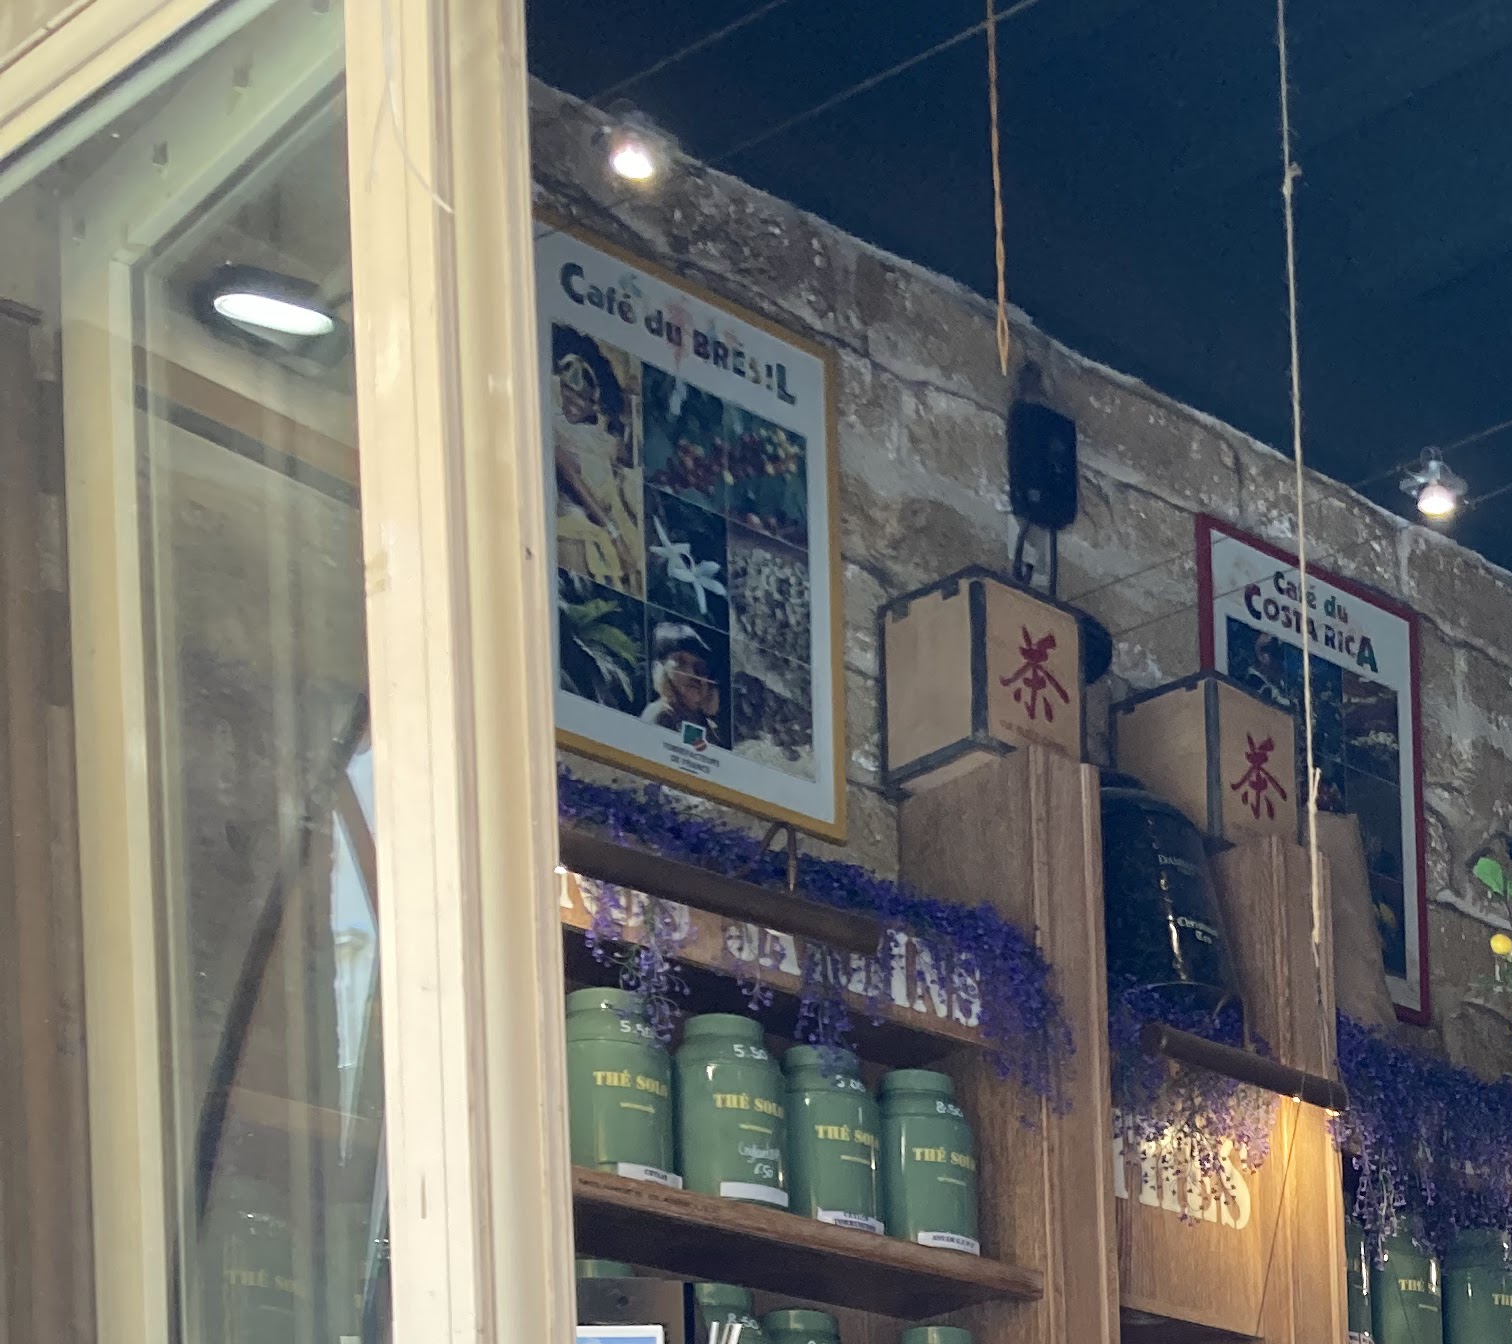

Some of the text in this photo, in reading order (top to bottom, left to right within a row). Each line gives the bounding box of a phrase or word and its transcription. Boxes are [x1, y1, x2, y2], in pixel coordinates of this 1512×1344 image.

[559, 262, 683, 347] Café du
[1324, 595, 1349, 624] du
[1323, 623, 1379, 674] RICA
[592, 1068, 632, 1088] THÉ
[712, 1091, 751, 1110] THÉ
[814, 1124, 851, 1142] THÉ
[911, 1146, 947, 1164] THÉ
